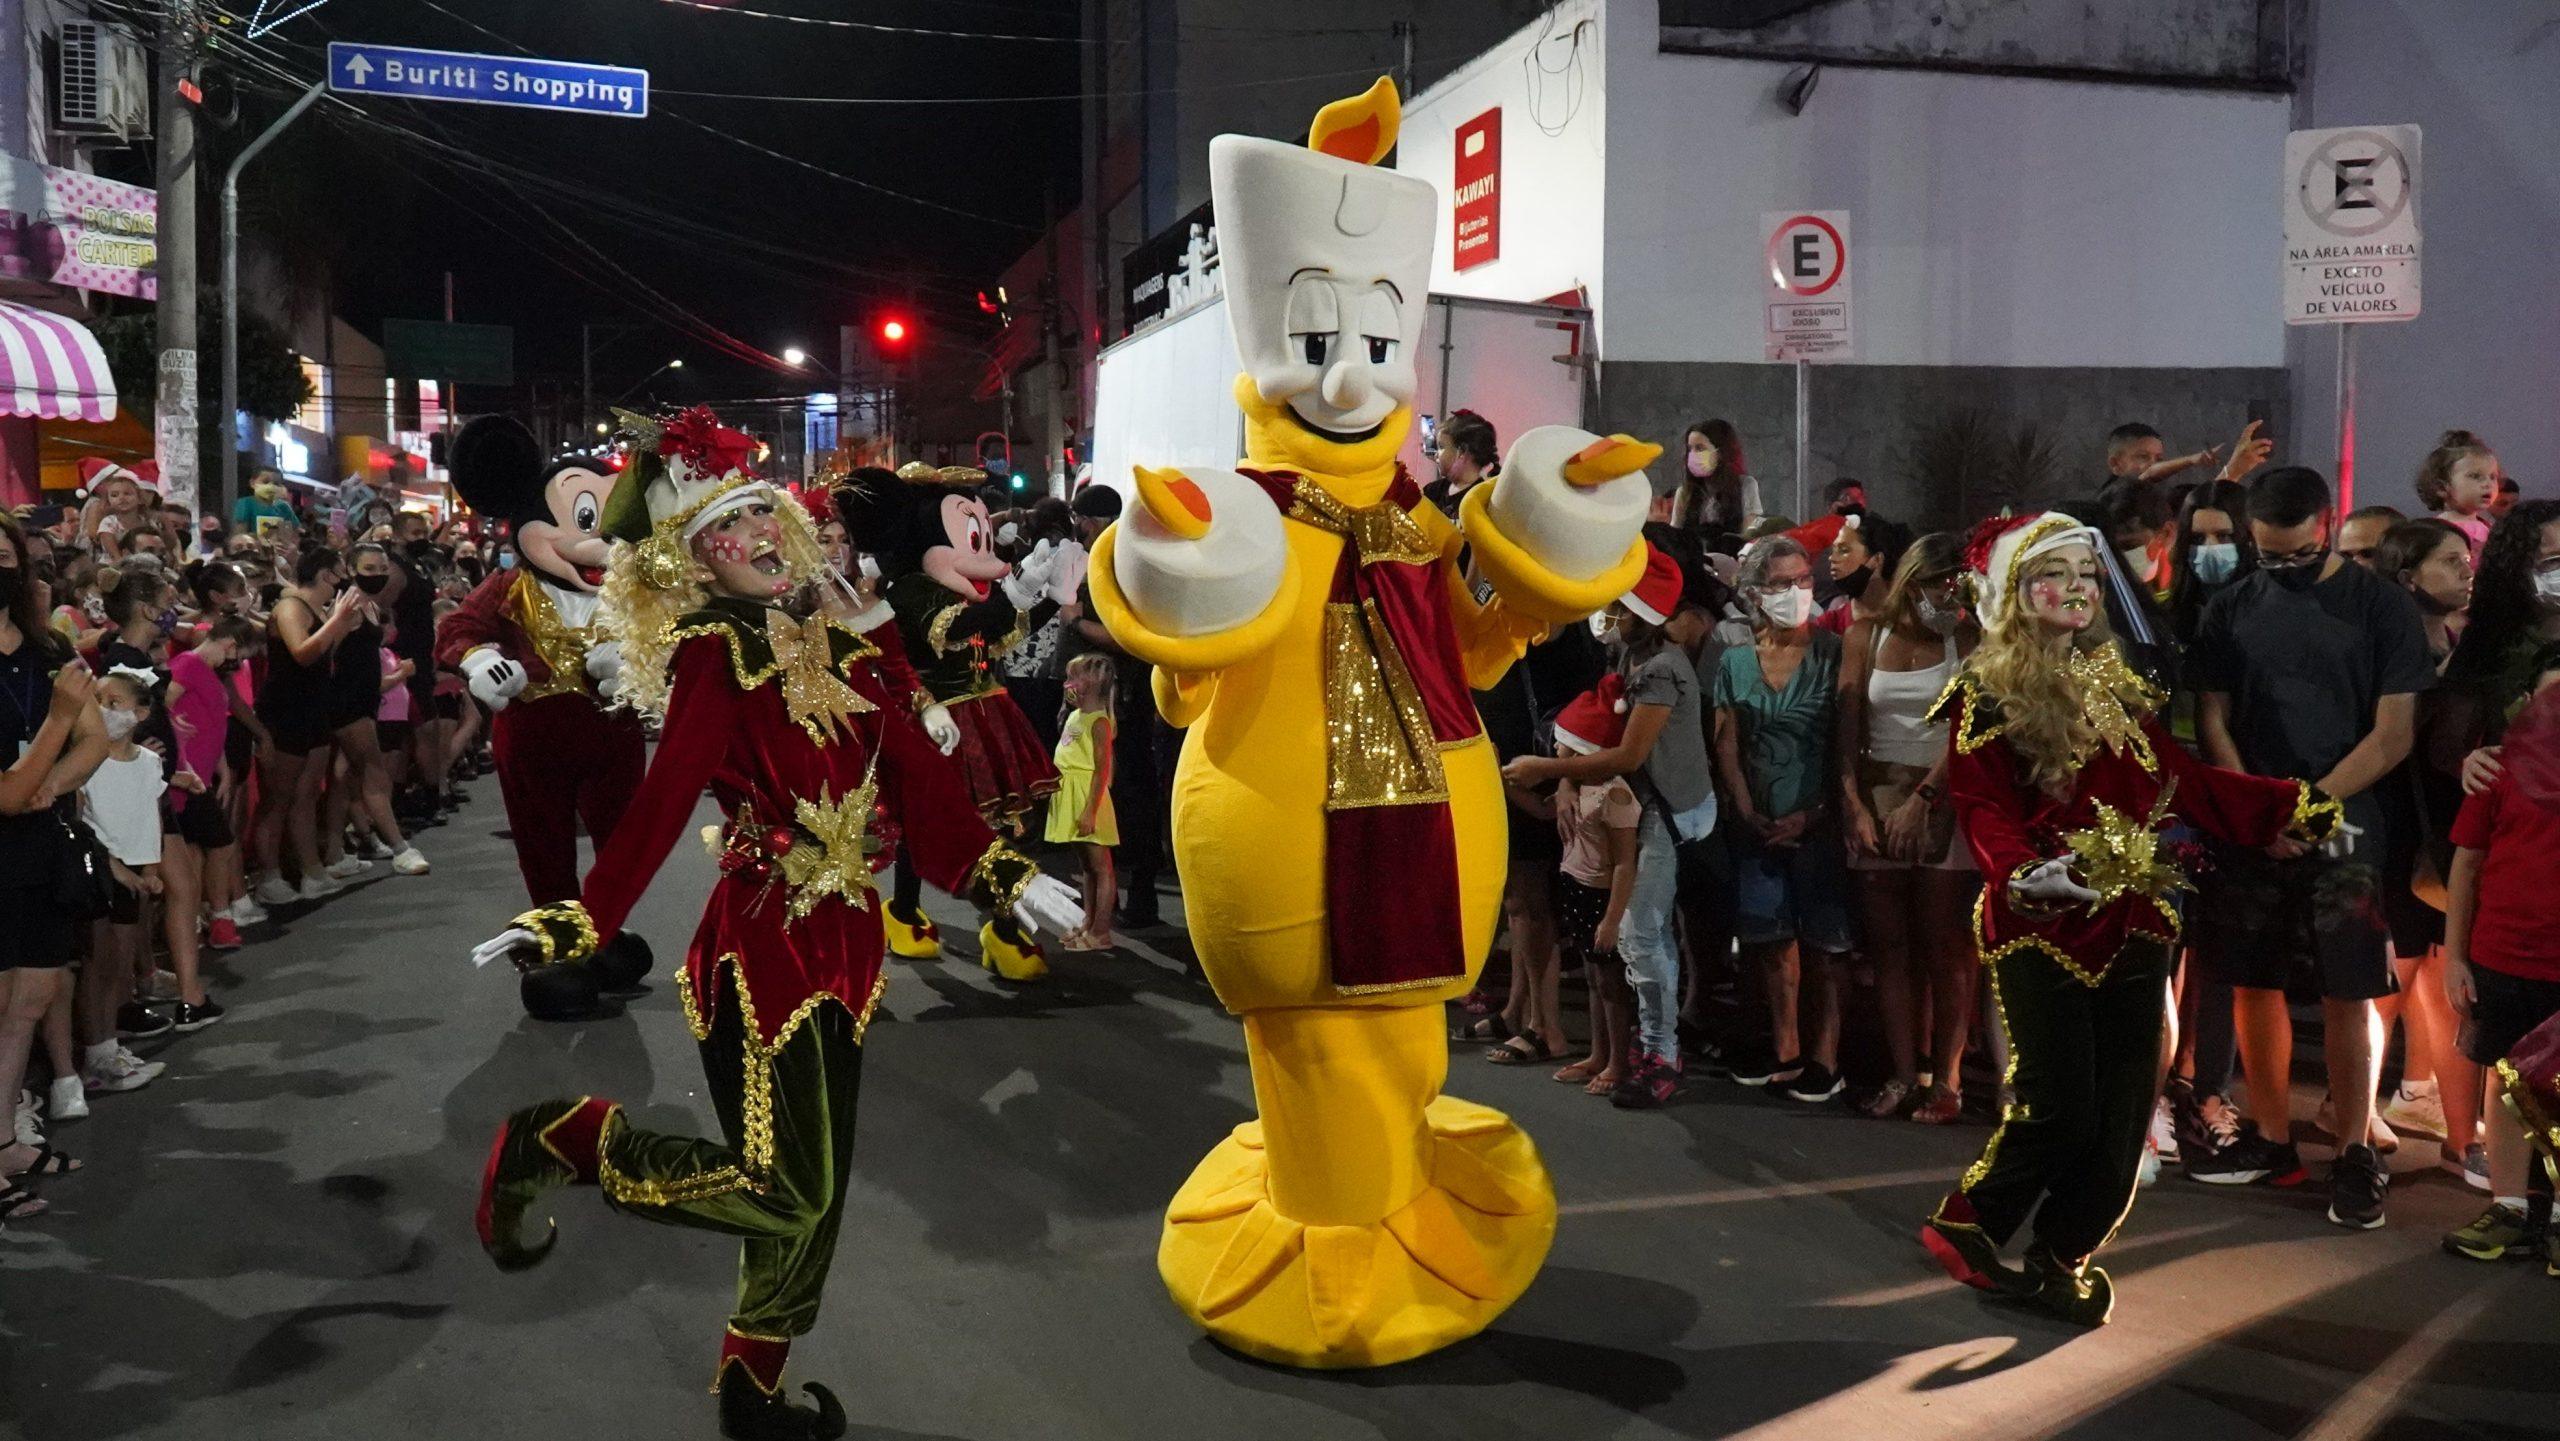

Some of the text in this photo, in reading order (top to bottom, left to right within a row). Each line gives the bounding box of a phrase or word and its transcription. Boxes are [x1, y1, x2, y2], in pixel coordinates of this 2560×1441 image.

[385, 60, 633, 109] Buriti Shopping
[1455, 173, 1494, 208] KAWAYI
[84, 207, 155, 237] BOLSAS
[1459, 216, 1488, 235] Bijuterias
[1458, 232, 1488, 252] Presentes
[1793, 234, 1819, 276] E
[2289, 243, 2415, 260] NA ÁREA AMARELA
[2324, 265, 2383, 279] EXCETO
[2321, 281, 2385, 296] VEÍCULO
[1792, 308, 1841, 317] EXCLUSIVO
[2306, 299, 2397, 315] DE VALORES
[1792, 318, 1821, 326] IDOSO
